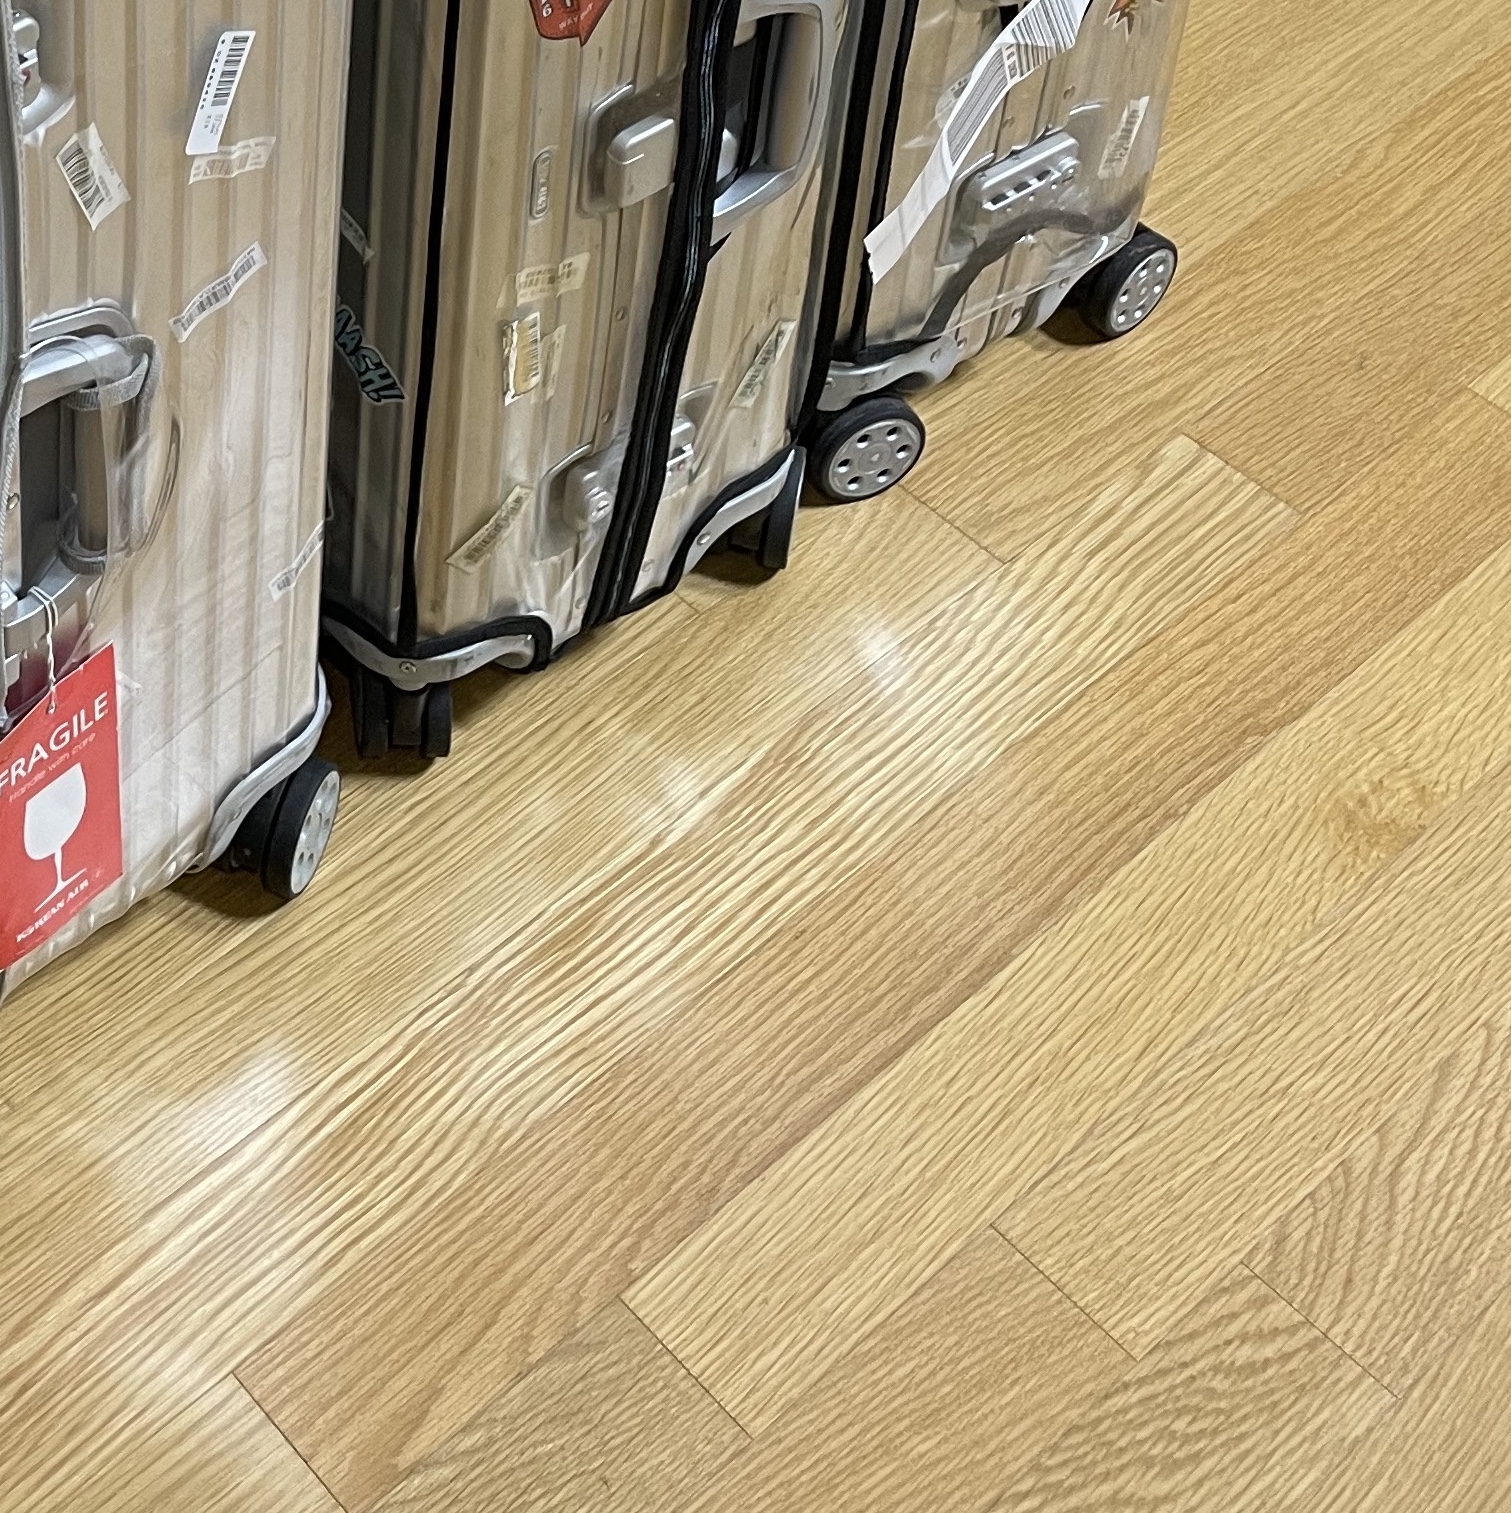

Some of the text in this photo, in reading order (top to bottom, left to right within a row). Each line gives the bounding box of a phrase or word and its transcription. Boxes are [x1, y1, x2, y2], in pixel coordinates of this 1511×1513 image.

[558, 14, 579, 30] WAY
[16, 898, 65, 943] KOREAN
[66, 879, 89, 904] AIR
